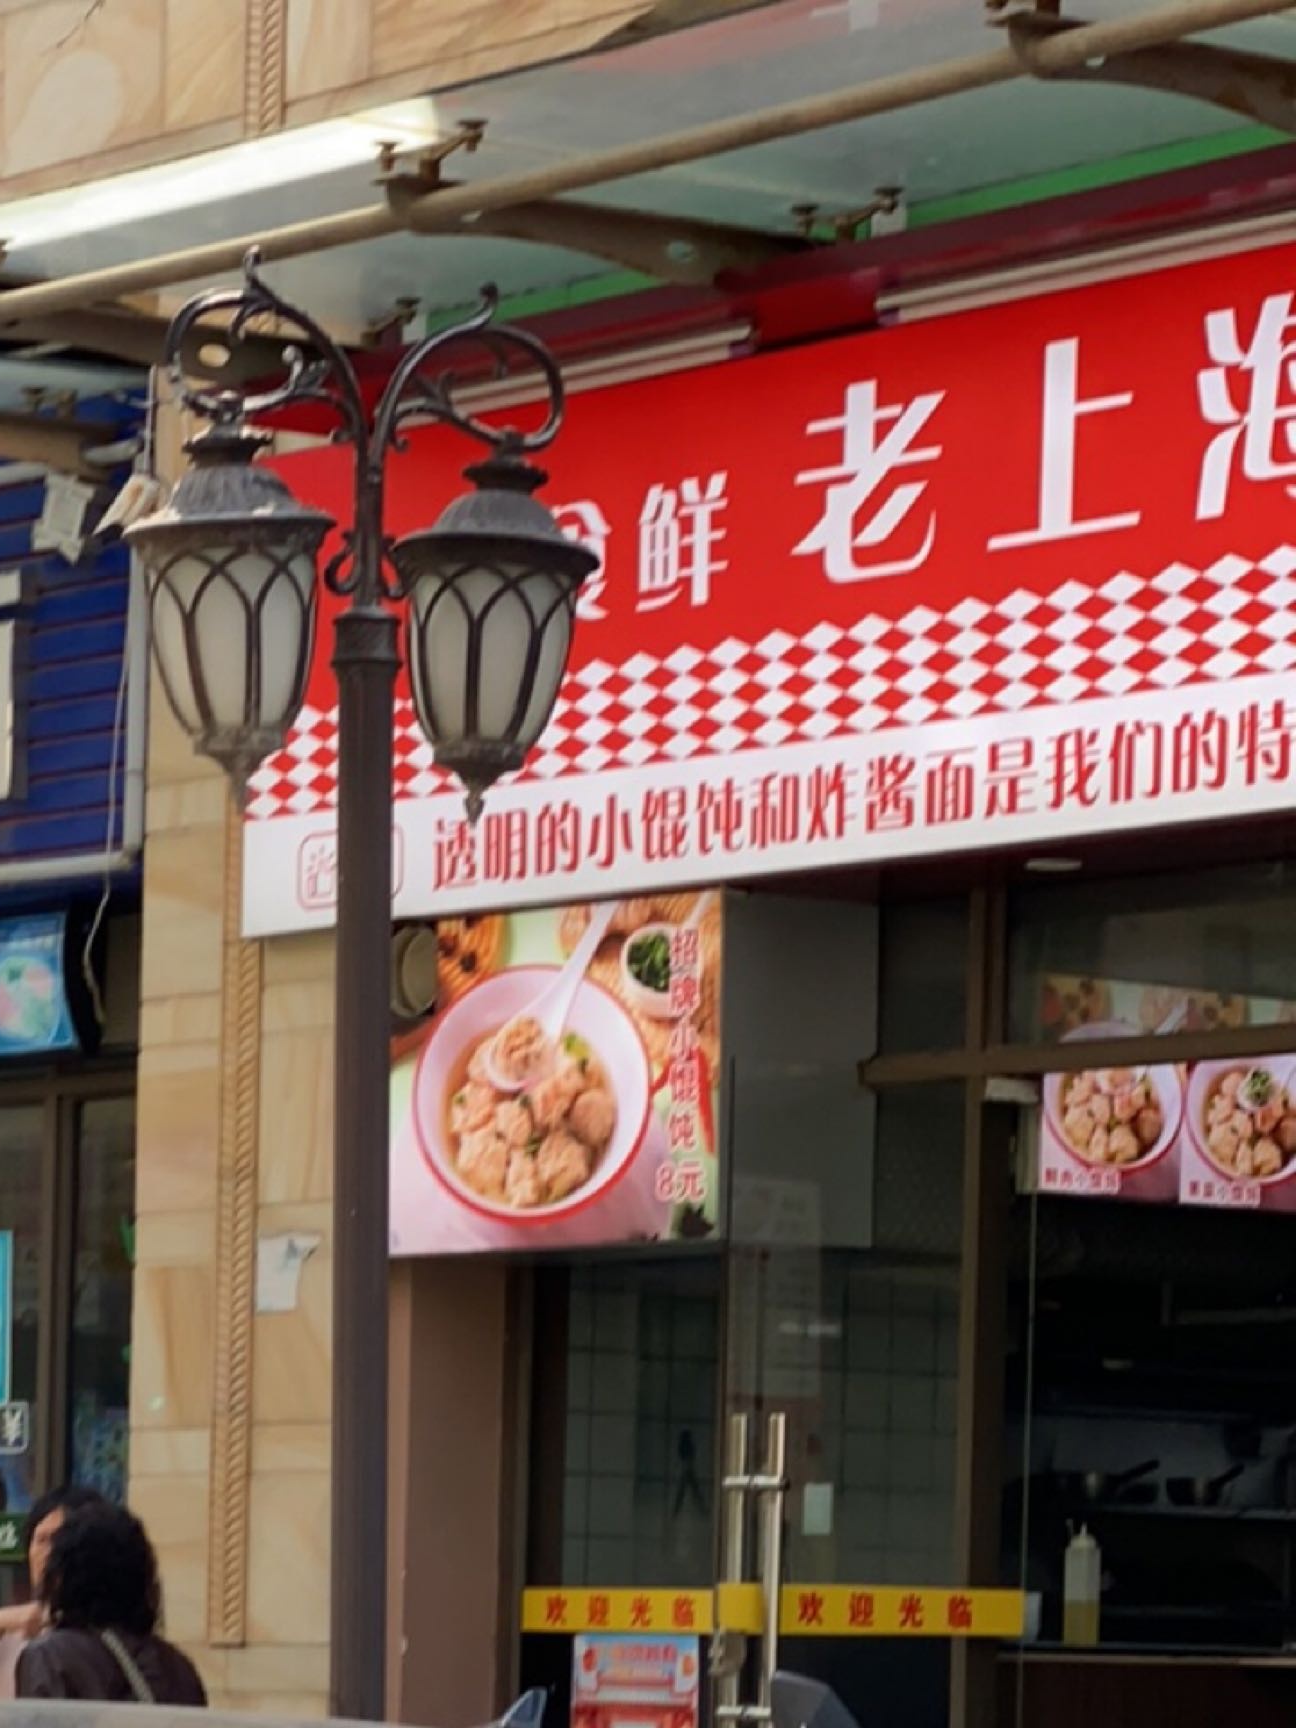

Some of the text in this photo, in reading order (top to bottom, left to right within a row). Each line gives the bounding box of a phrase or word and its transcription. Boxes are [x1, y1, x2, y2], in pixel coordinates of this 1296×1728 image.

[432, 698, 1296, 892] 透明的小馄饨和炸酱面是我们的特
[545, 1595, 695, 1627] 欢迎光临
[798, 1593, 973, 1629] 欢迎光临
